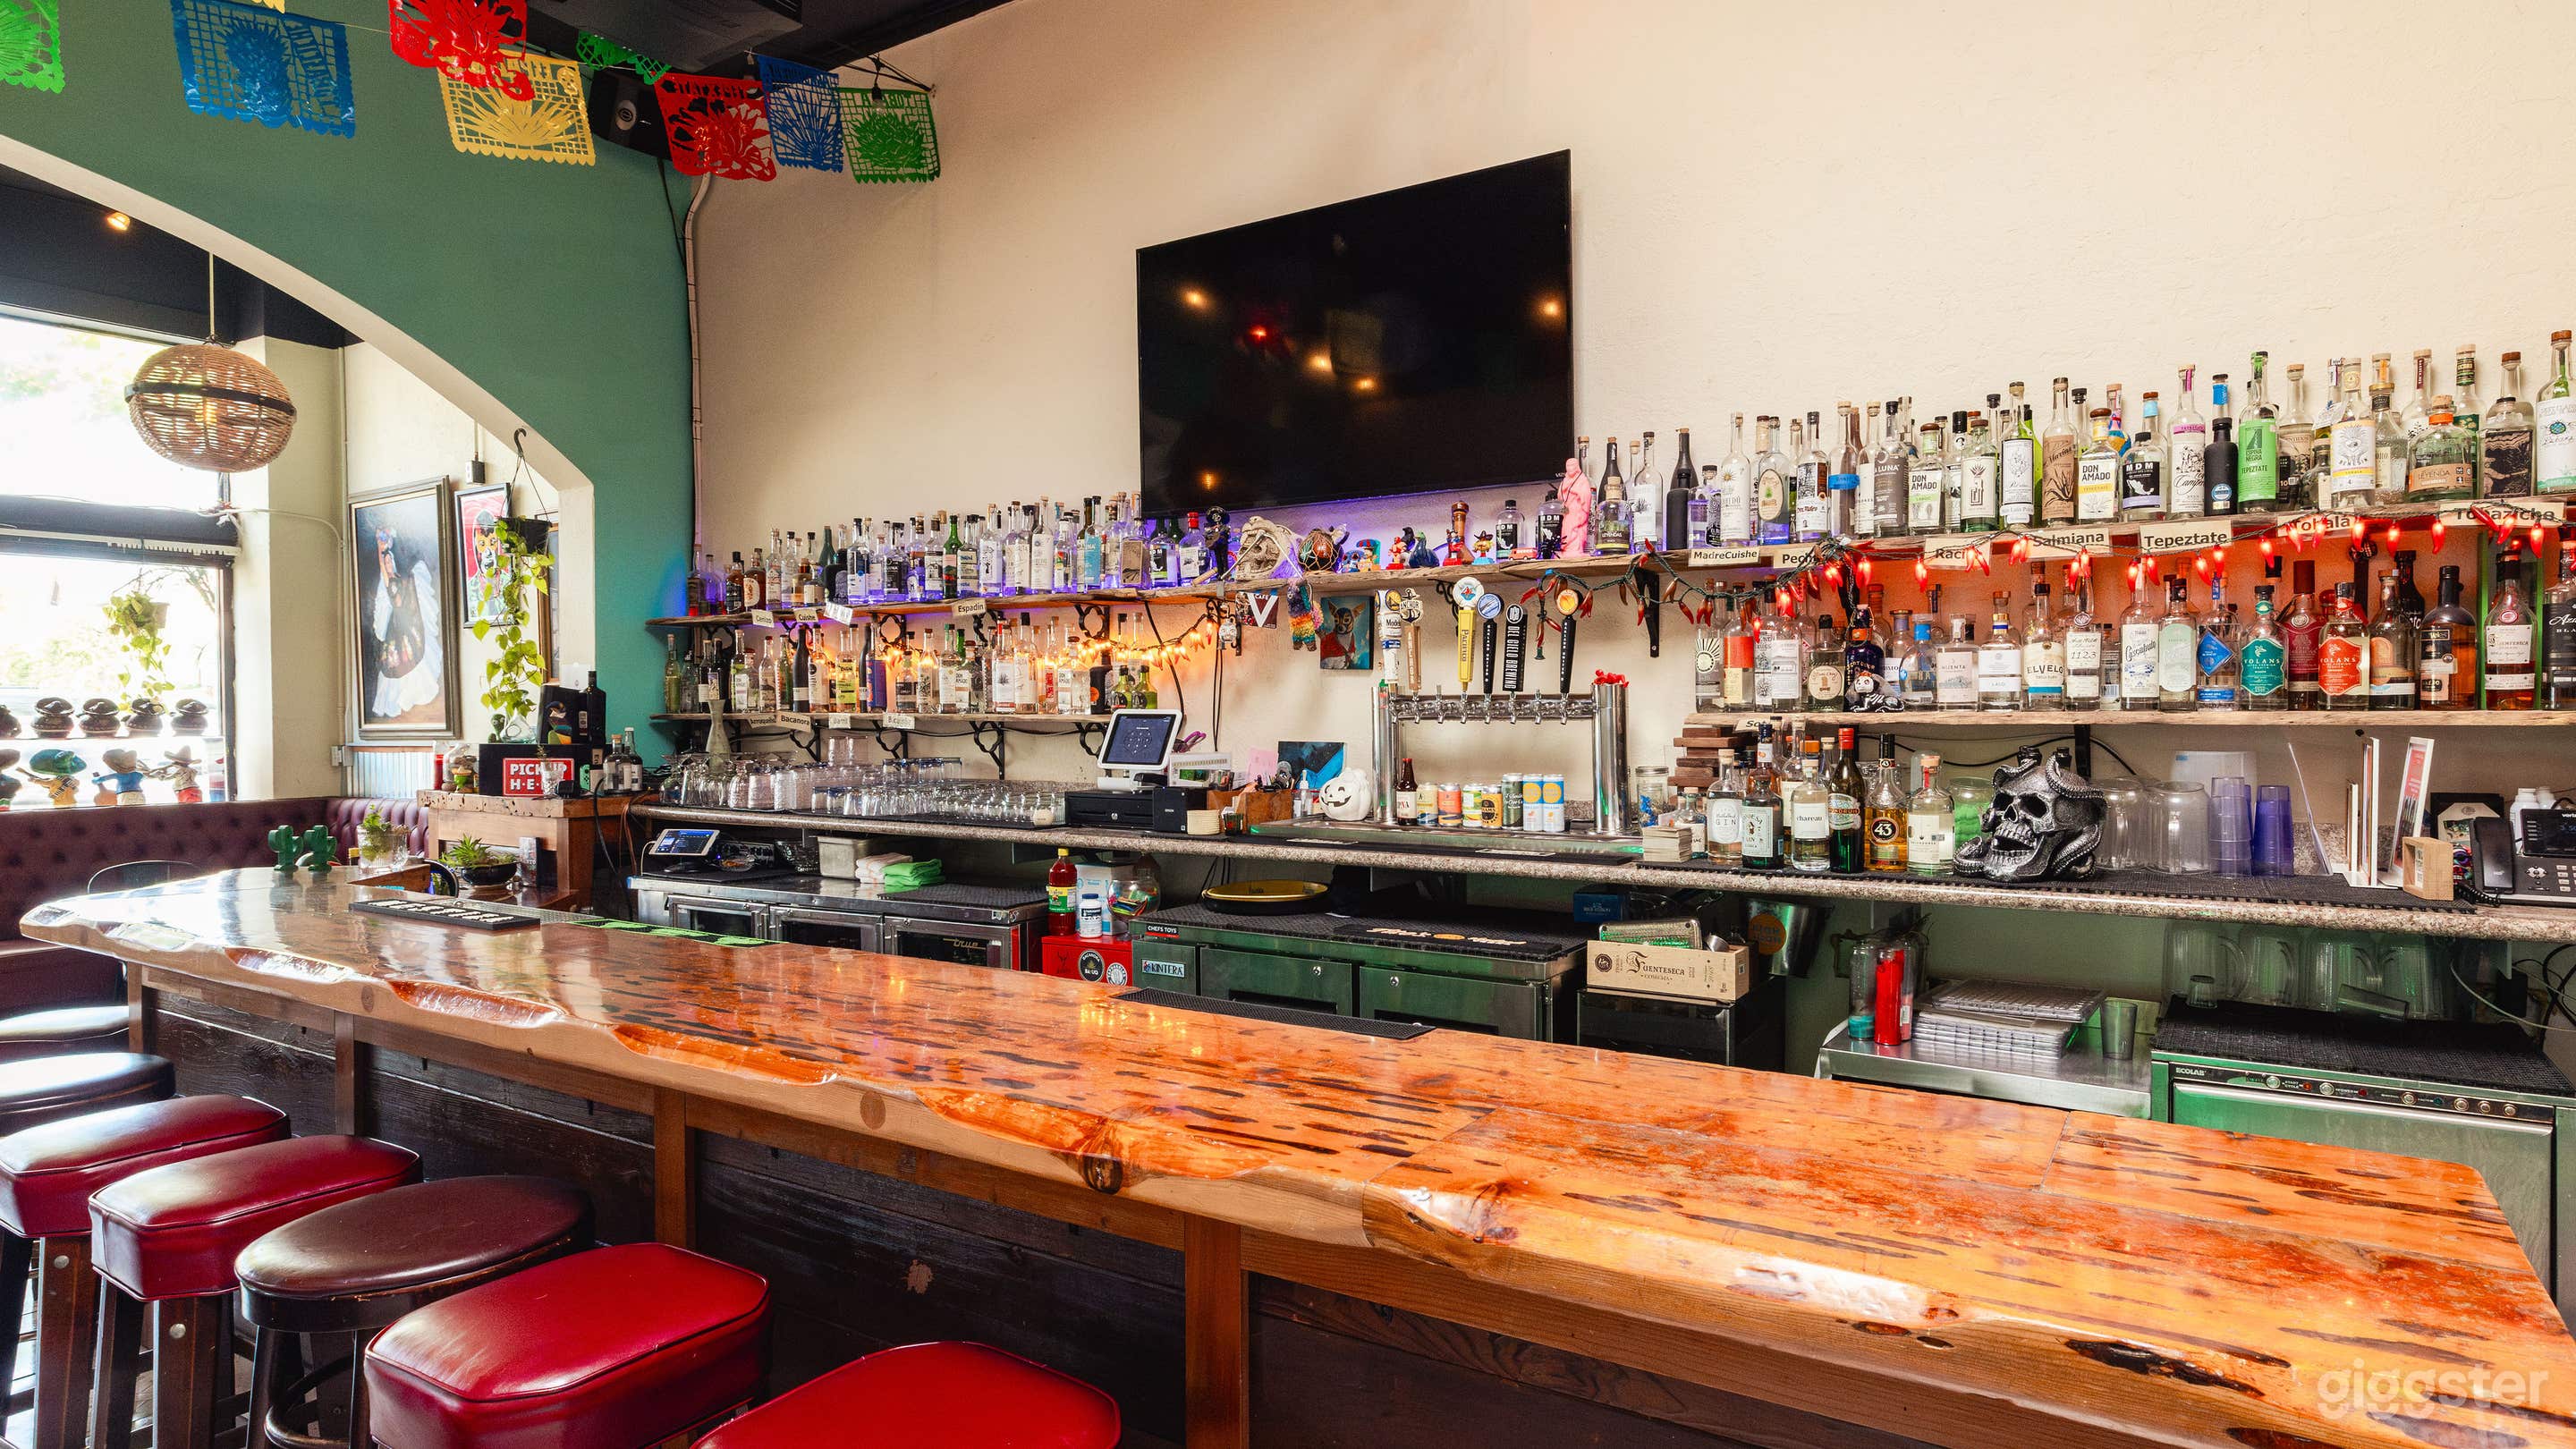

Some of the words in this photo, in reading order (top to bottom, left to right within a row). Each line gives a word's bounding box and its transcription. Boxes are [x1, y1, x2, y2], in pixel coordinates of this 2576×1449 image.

[2082, 464, 2099, 473] DON
[1911, 474, 1927, 482] DON
[2081, 472, 2111, 481] AMADO
[2418, 470, 2450, 480] LEYENDA
[1911, 481, 1937, 490] AMADO
[2457, 507, 2555, 521] Toaziche
[2034, 531, 2105, 547] Salmiana
[2144, 530, 2227, 548] Tepeztate
[1693, 550, 1758, 561] MadreCuishe
[1507, 626, 1520, 637] DEL
[1506, 639, 1519, 658] CIELO
[1504, 659, 1518, 689] BREWING
[781, 715, 810, 726] Bacanora
[510, 763, 542, 775] PICK
[1875, 823, 1893, 836] 43
[1163, 926, 1177, 934] TOYS
[1151, 961, 1183, 976] KINTERA
[2175, 1067, 2205, 1076] ECOLAB
